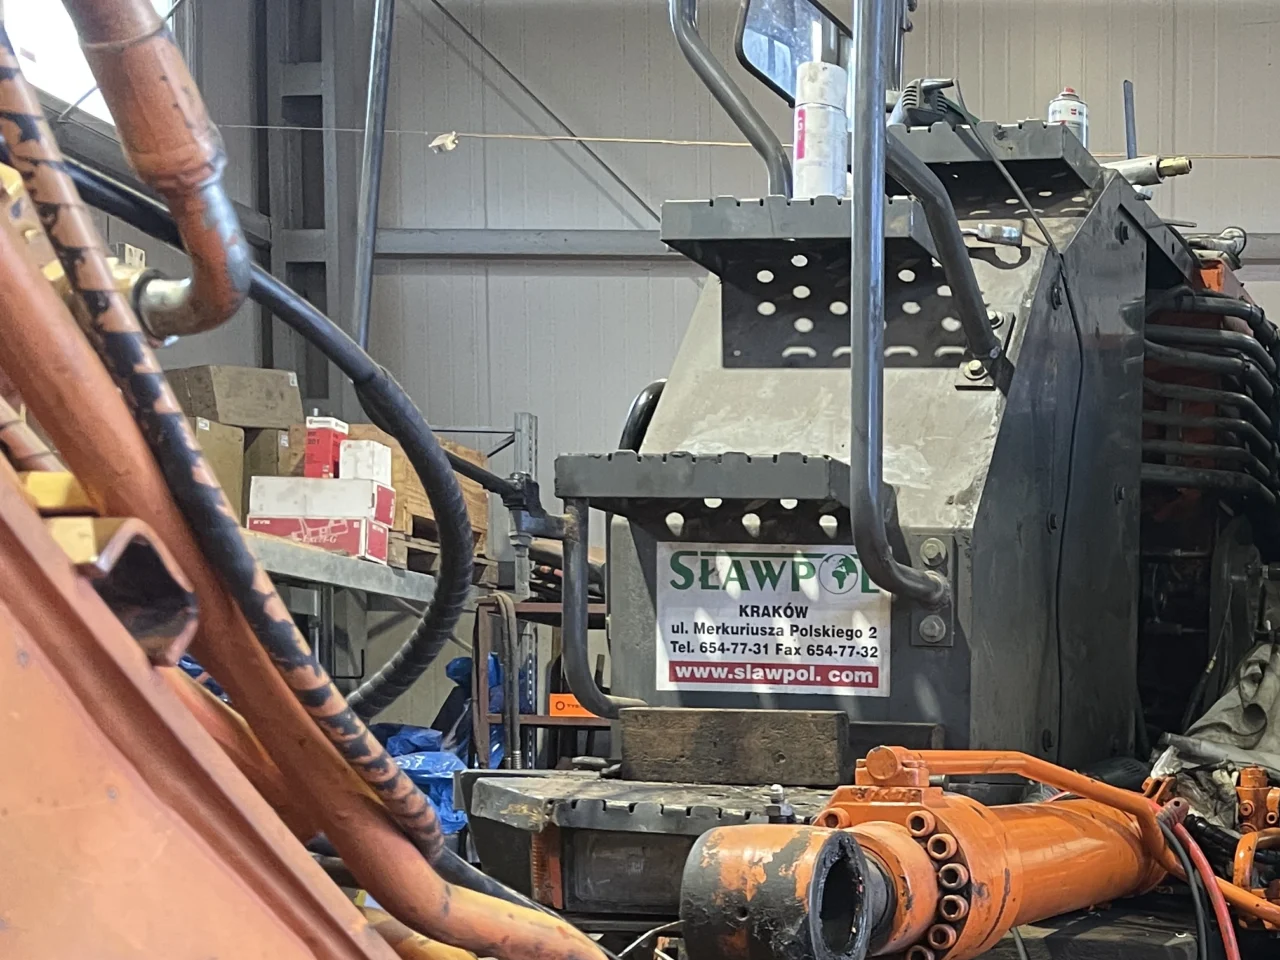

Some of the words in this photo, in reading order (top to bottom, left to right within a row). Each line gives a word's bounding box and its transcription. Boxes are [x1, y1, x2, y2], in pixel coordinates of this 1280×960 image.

[738, 602, 809, 619] KRAKÓW
[671, 622, 689, 635] ul.
[693, 622, 785, 637] Merkuriusza
[789, 624, 863, 641] Polskiego
[868, 626, 878, 639] 2
[670, 640, 695, 654] Tel.
[699, 641, 769, 655] 654-77-31
[775, 643, 802, 656] Fax
[806, 644, 878, 658] 654-77-32
